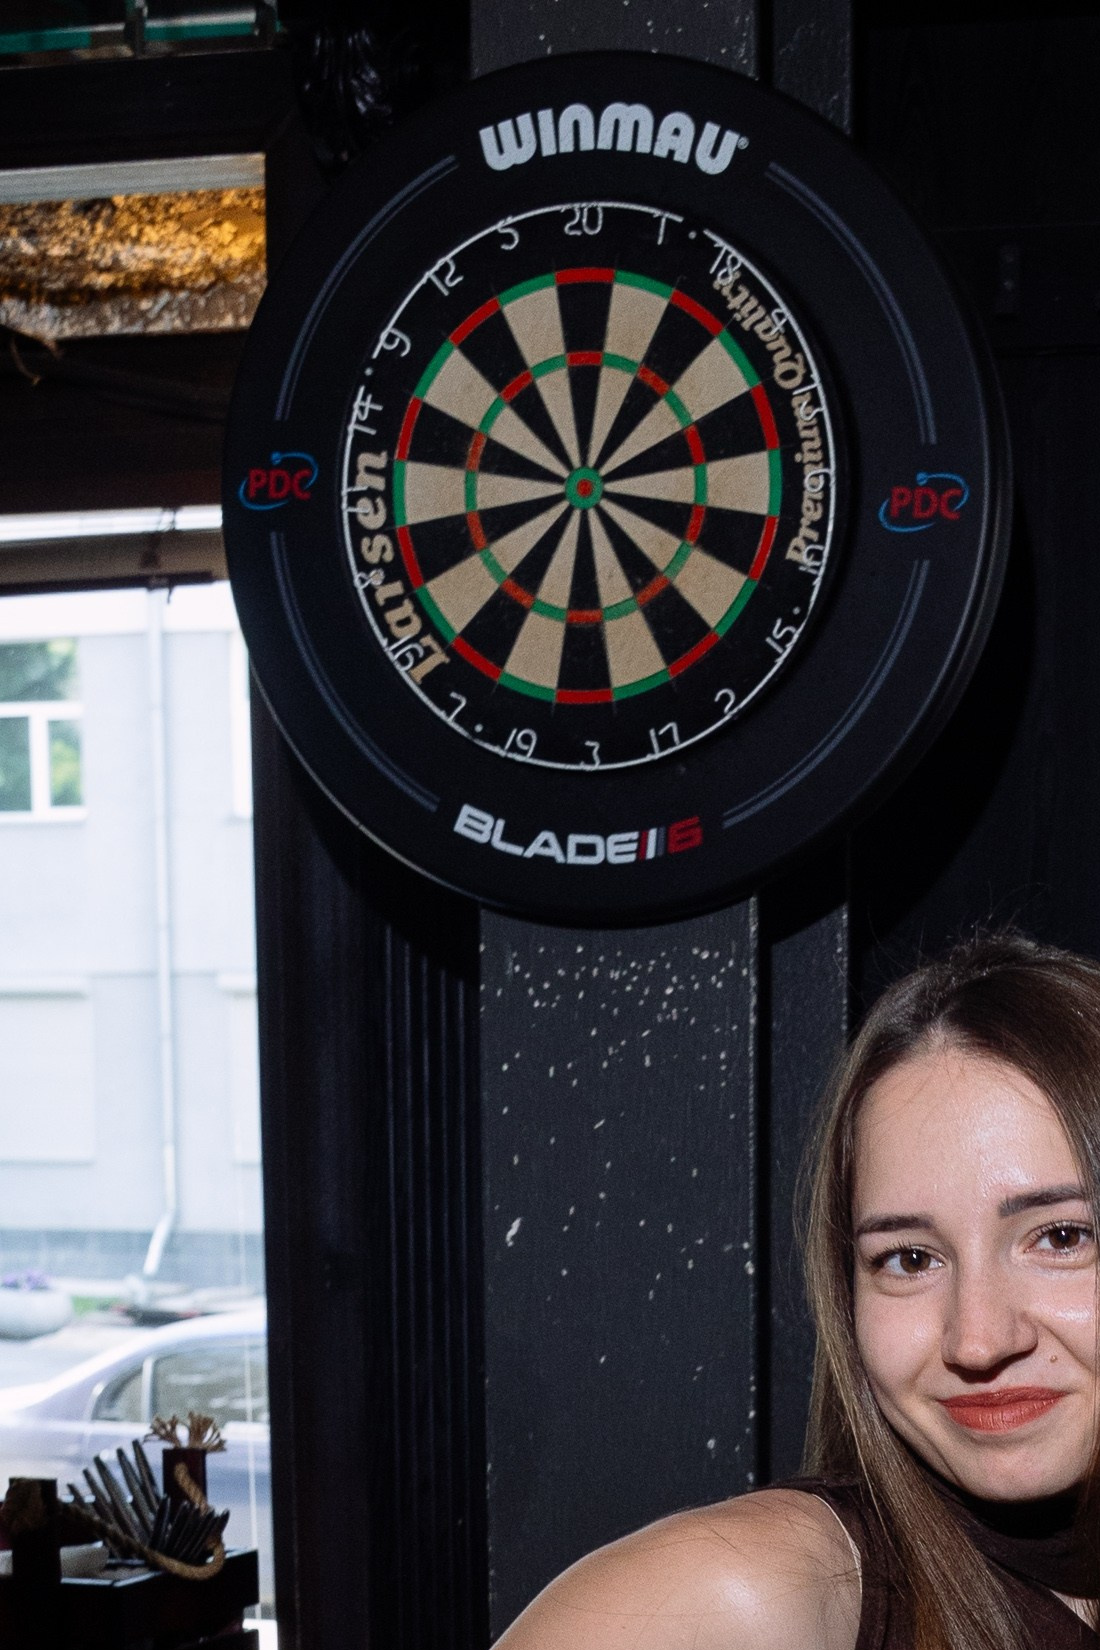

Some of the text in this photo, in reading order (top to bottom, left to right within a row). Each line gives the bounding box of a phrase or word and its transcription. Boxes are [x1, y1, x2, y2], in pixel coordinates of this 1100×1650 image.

[497, 216, 520, 250] 5
[560, 202, 603, 236] 20
[423, 258, 464, 297] 12
[709, 242, 743, 286] 18
[381, 327, 411, 358] 9
[349, 394, 383, 435] 14
[248, 468, 312, 500] PDC
[890, 486, 962, 520] PDC
[355, 450, 450, 684] Larsen
[383, 632, 425, 673] 16
[765, 617, 798, 664] 15
[449, 690, 468, 723] 7
[502, 728, 538, 759] 19
[648, 722, 681, 758] 17
[453, 803, 639, 865] BLADE
